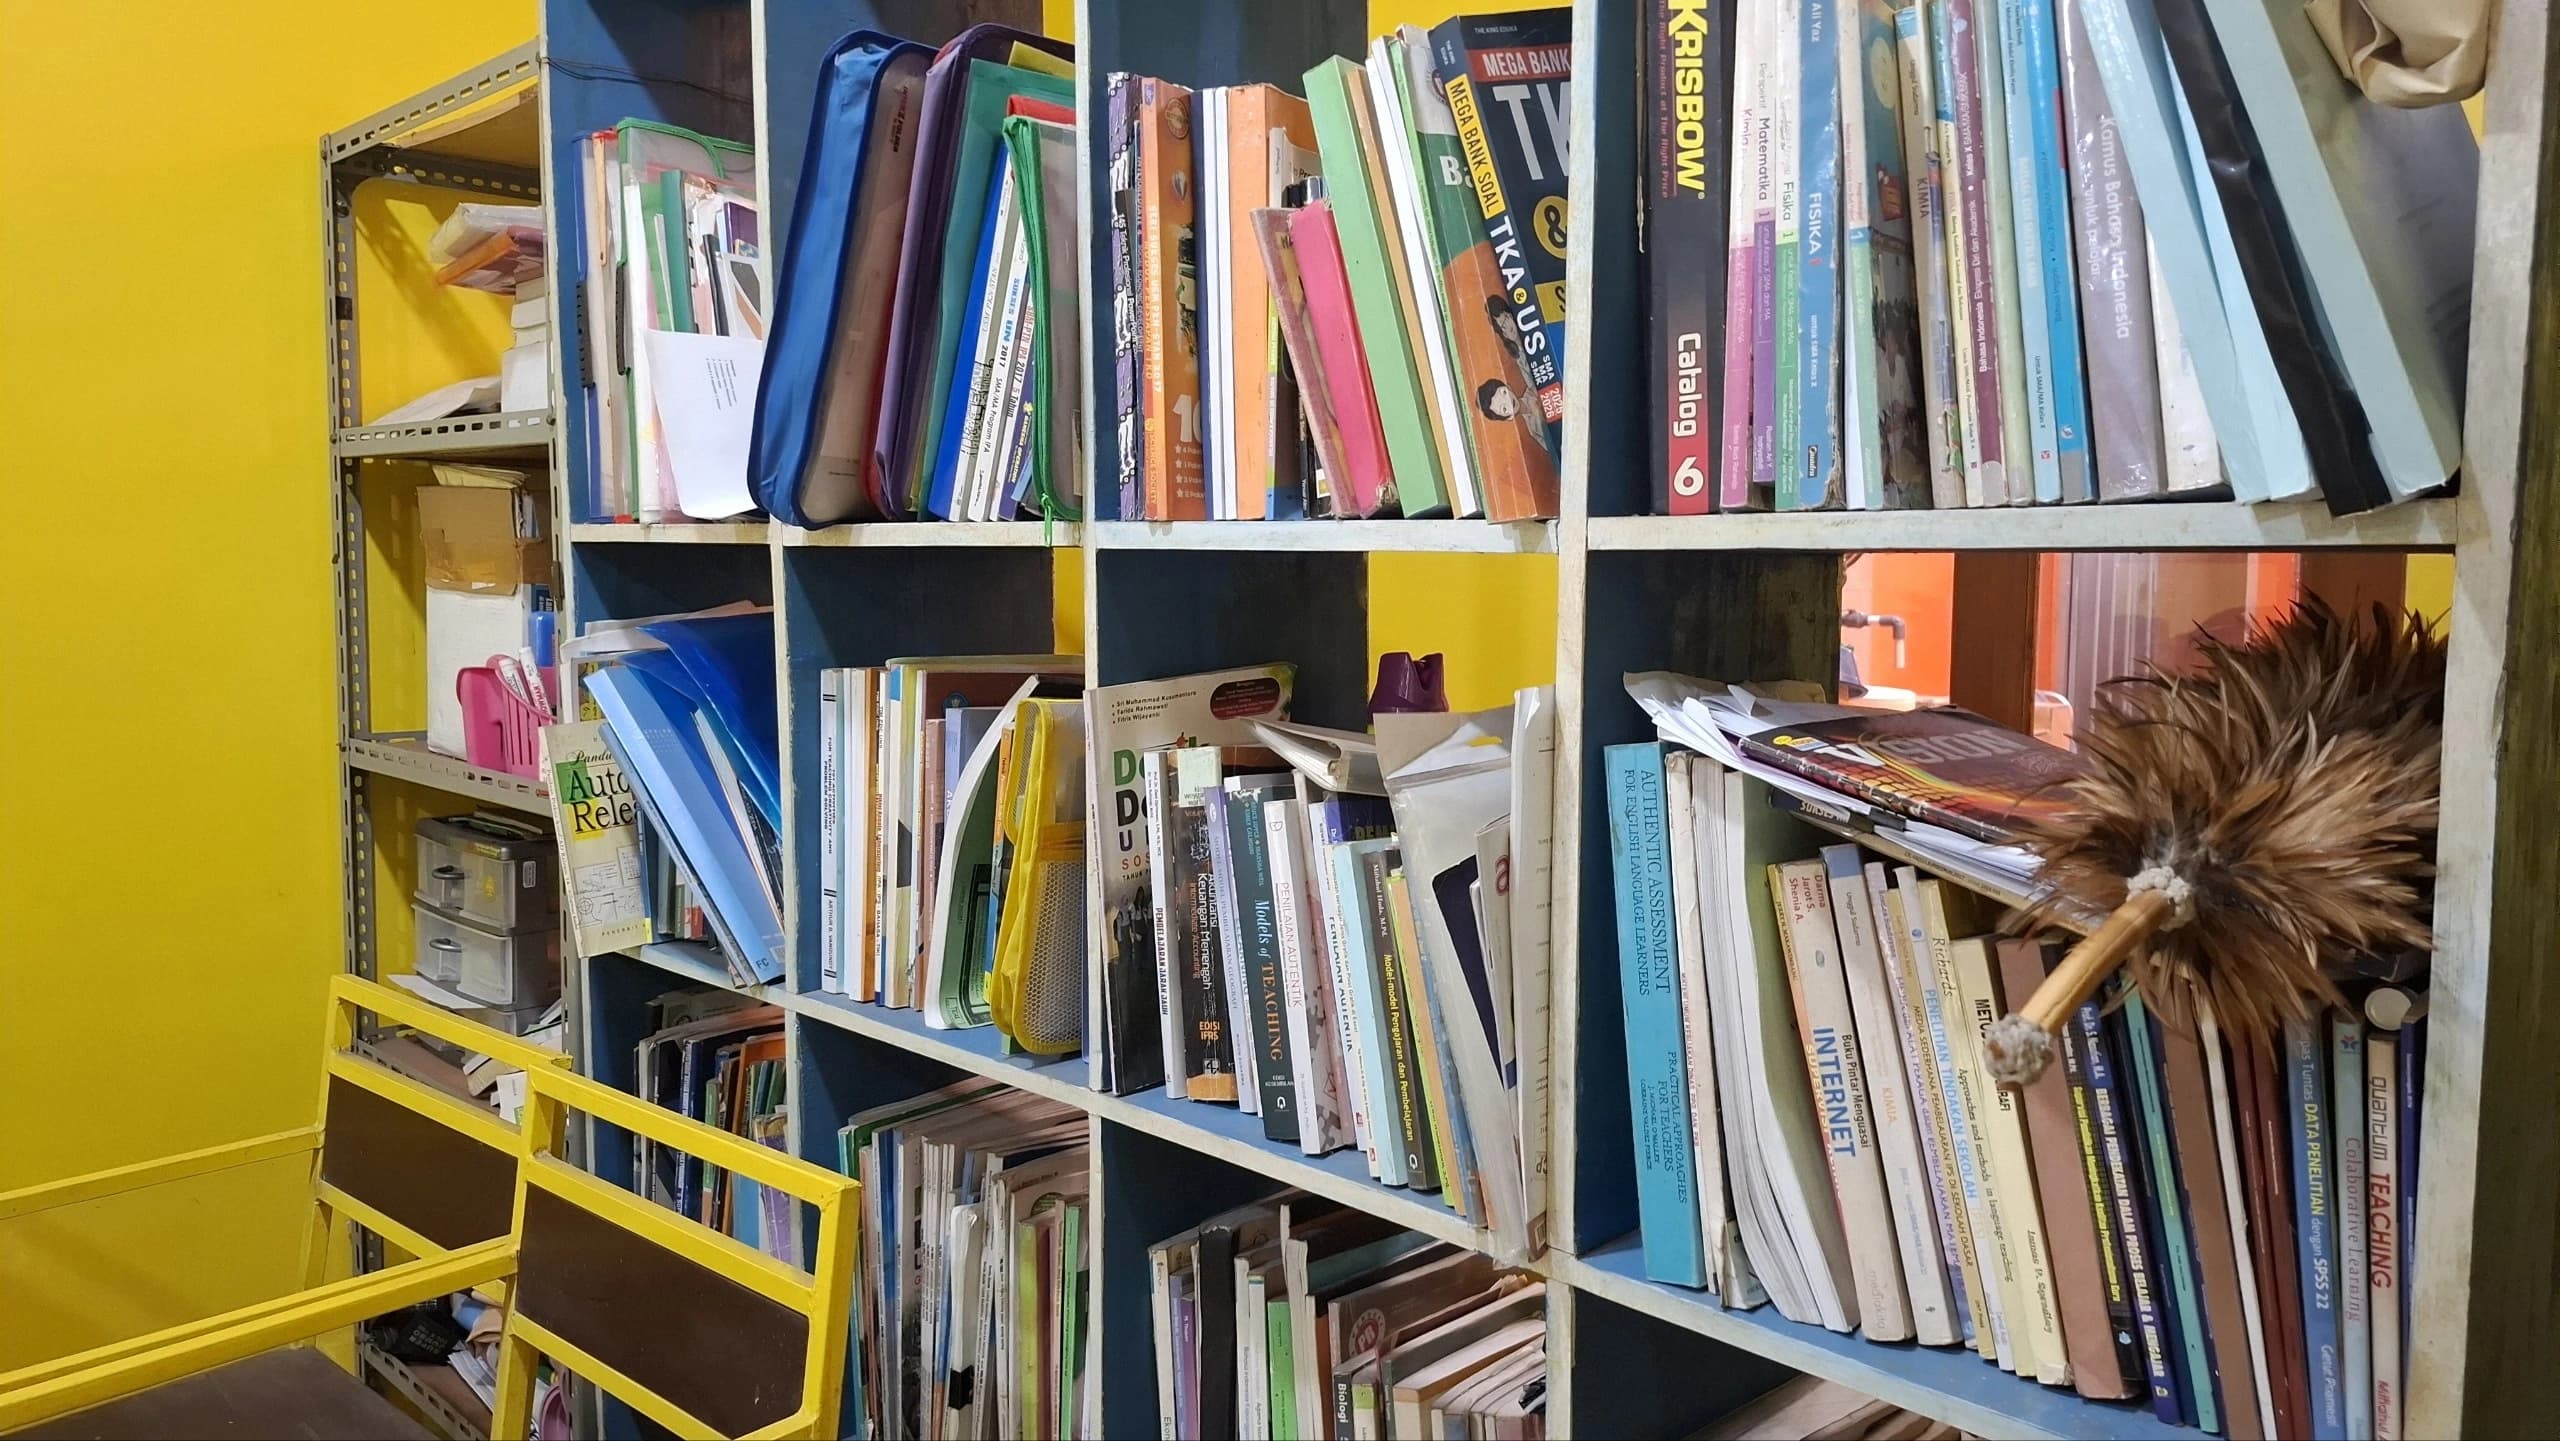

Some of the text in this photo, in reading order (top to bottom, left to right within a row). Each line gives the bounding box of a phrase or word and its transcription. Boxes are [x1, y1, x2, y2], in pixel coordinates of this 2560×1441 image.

[1482, 48, 1572, 77] MEGA BANK
[1669, 0, 1707, 191] KRISBOW
[1657, 22, 1669, 197] Right Product at The Right Price
[1741, 108, 1751, 144] Kimia
[1448, 81, 1500, 213] MEGA BANK SOAL
[1758, 117, 1769, 199] Matematika
[1964, 149, 1975, 173] Kelas
[1782, 181, 1793, 220] Fisika
[1808, 192, 1821, 253] FISIKA
[1916, 177, 1930, 218] KIMIA
[2097, 115, 2133, 338] Kamus Bahasa Indonesia
[1117, 214, 1134, 296] 145 Teknik Profesional
[1485, 215, 1547, 357] TKA US
[1968, 198, 1989, 371] Bahasa Indonesia dan Akademik
[998, 344, 1008, 367] 2017
[1002, 319, 1012, 342] UN
[1006, 361, 1025, 418] 2017 Tahun
[1530, 360, 1542, 385] SMK
[1538, 365, 1548, 384] MA
[1542, 355, 1554, 380] SMA
[1549, 388, 1562, 415] 2025
[2034, 375, 2047, 424] SMA/MA Kelas
[982, 376, 1003, 453] SMA/MA Program IPA
[1540, 392, 1553, 418] 2026
[1673, 332, 1703, 496] Catalog 6
[1117, 703, 1168, 716] Farida Rahmawati
[1126, 695, 1160, 706] Muhammad
[1133, 712, 1161, 721] Wijayanti
[1208, 873, 1218, 927] Akuntansi
[1372, 863, 1388, 937] Miftahul Huda, M.Pd.
[1623, 770, 1650, 997] FOR ENGLISH LANGUAGE LEARNERS
[1639, 768, 1670, 994] AUTHENTIC ASSESSMENT
[1788, 877, 1804, 923] Shenia A.
[1801, 876, 1814, 912] Jarot S.
[1814, 875, 1827, 907] Darma
[1197, 873, 1212, 989] Keuangan Menengah
[1213, 836, 1238, 1009] MODEL-MODEL PEMBELAJARAN GEOGRAFI
[1254, 898, 1272, 944] Models
[1257, 947, 1271, 959] of
[1279, 881, 1303, 1008] PENILAIAN AUTENTIK
[756, 956, 770, 971] FC
[1155, 907, 1170, 1015] PEMBELAJARAN JARAK JAUH
[1932, 936, 1956, 997] Richards
[1199, 1020, 1220, 1032] EDISI
[1200, 1031, 1219, 1042] IFRS
[1260, 962, 1282, 1061] TEACHING
[1383, 954, 1414, 1141] Model-model Pengajaran dan Pembelajaran
[1659, 1081, 1674, 1172] FOR TEACHERS
[1667, 1050, 1687, 1204] PRACTICAL APPROACHES
[1813, 1026, 1855, 1160] INTERNET
[1841, 1034, 1871, 1148] Buku Pintar Menguasai
[1880, 1086, 1898, 1123] KIMIA
[1924, 987, 1977, 1199] PENELITIAN TINDAKAN SEKOLAH
[1649, 1092, 1660, 1164] MICHAEL O'MALLEY
[1913, 1005, 1973, 1267] MEDIA SEDERHANA PEMBELAJARAN IPS DI SEKOLAH DASAR
[1927, 1137, 1951, 1220] PEMBELAJARAN
[1956, 1069, 2016, 1283] Approaches and methods in language teaching
[2301, 1064, 2329, 1310] Tuntas DATA PENELITIAN dengan SPSS 22
[2095, 1087, 2165, 1378] BERBAGAI PENDEKATAN DALAM PROSES BELAJAR MENGAJAR
[2370, 1172, 2392, 1289] TEACHING
[2347, 1246, 2364, 1323] Learning
[1335, 1383, 1348, 1423] Biologi
